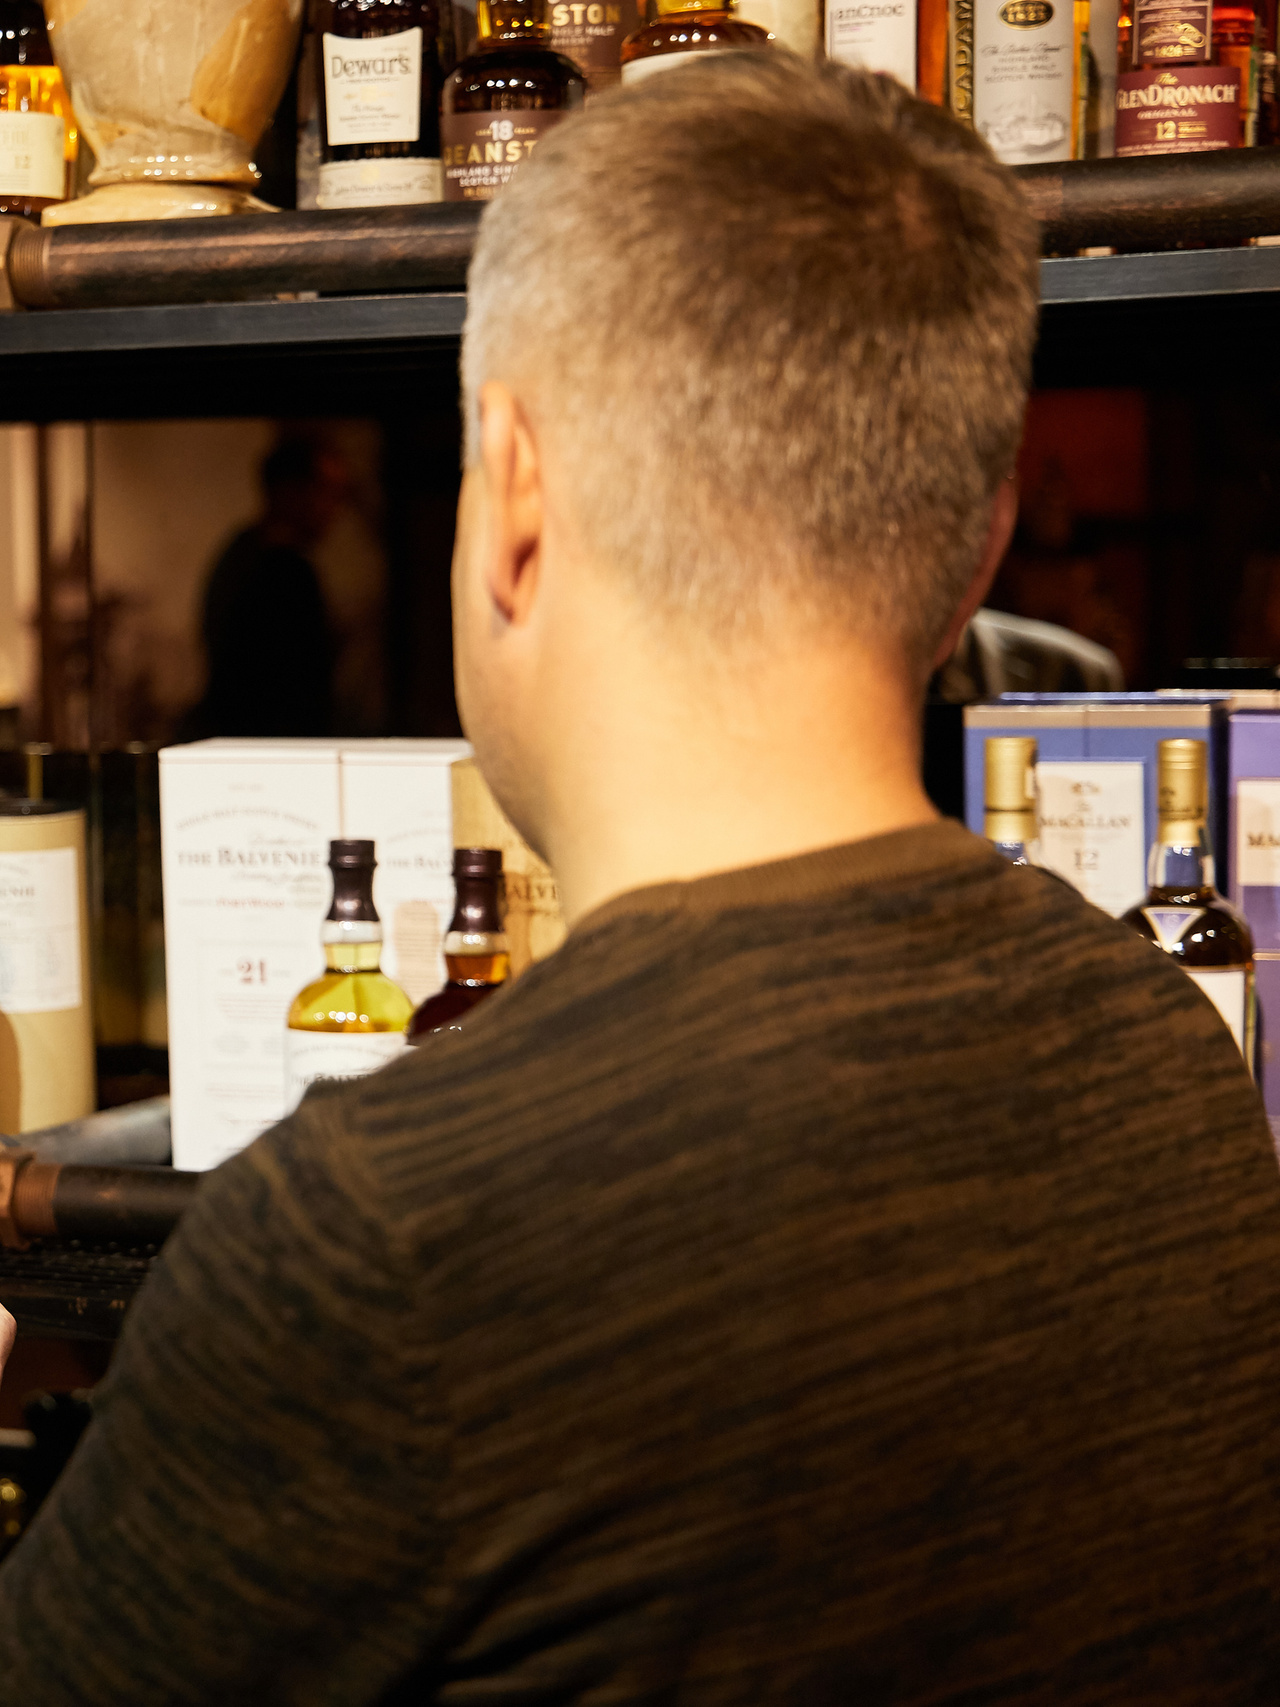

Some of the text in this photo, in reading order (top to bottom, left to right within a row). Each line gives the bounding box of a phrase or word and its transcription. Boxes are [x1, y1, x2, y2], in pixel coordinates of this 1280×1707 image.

[551, 3, 620, 27] STON
[331, 54, 412, 79] Dewar's
[489, 119, 515, 141] 18
[1155, 120, 1177, 141] 12
[218, 846, 321, 867] BALVENIE
[236, 958, 268, 986] 21
